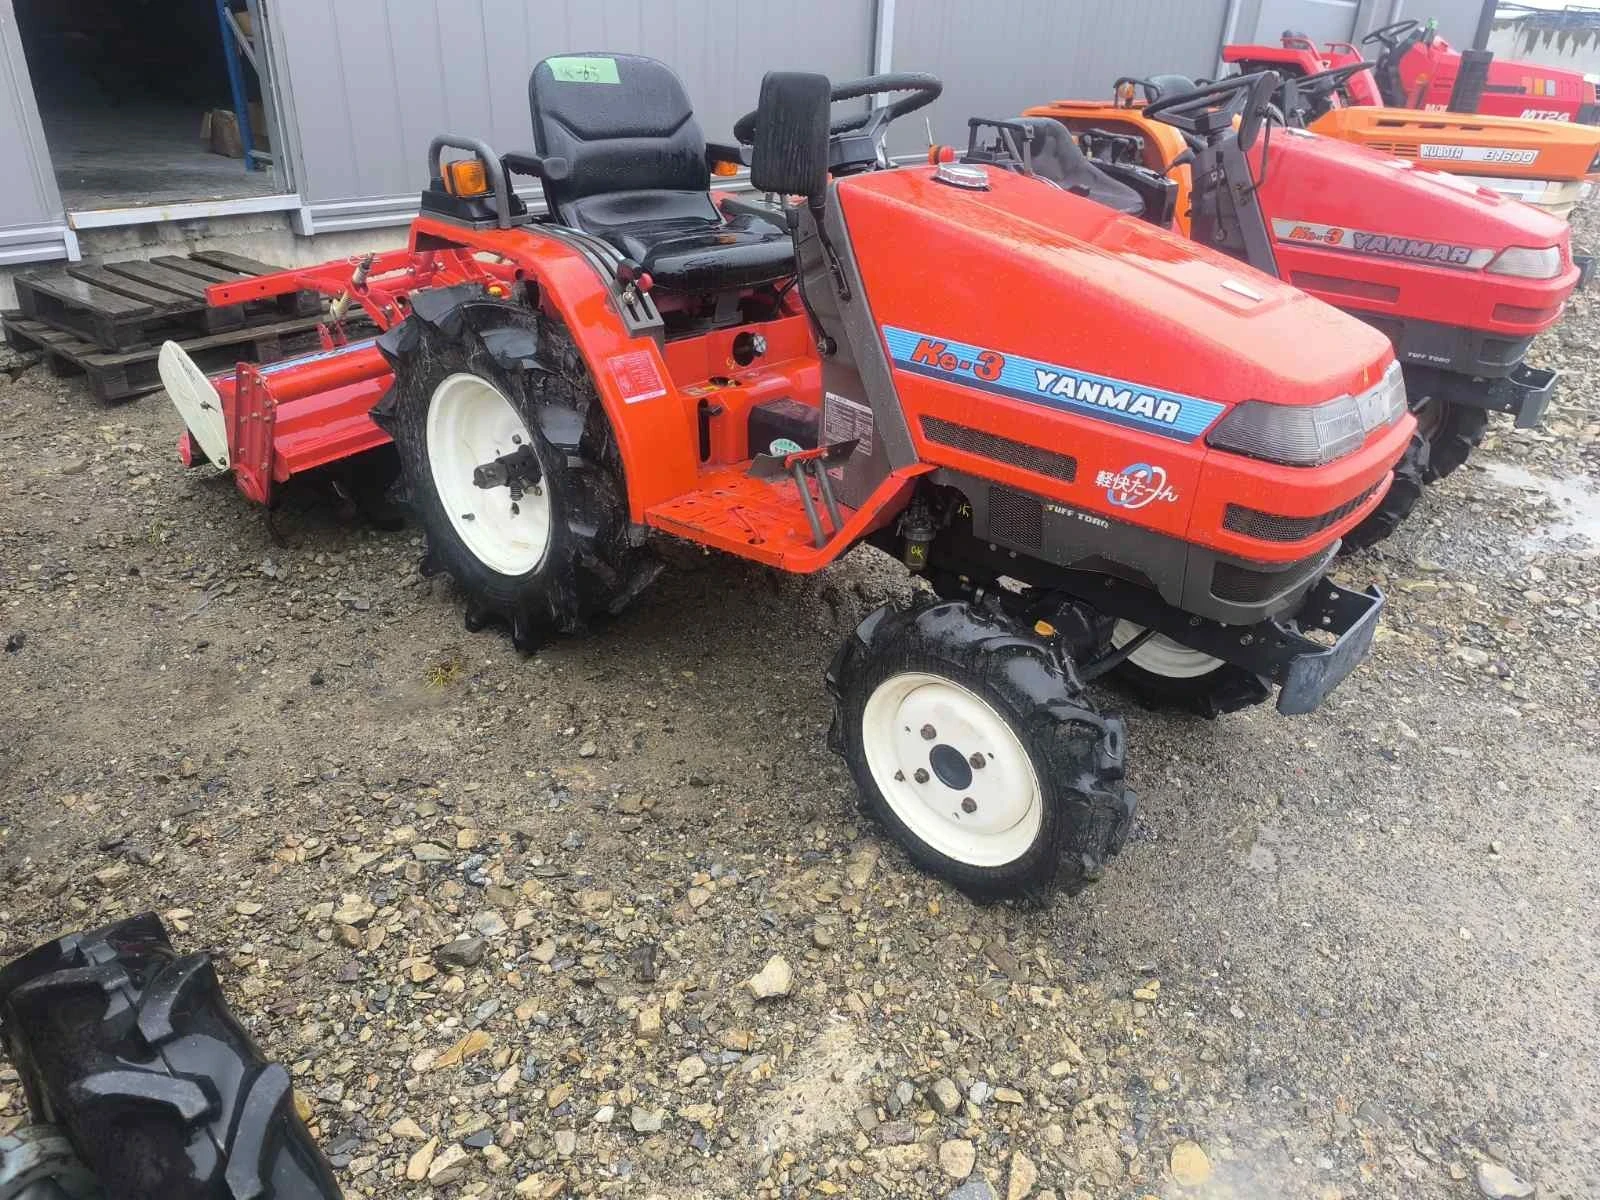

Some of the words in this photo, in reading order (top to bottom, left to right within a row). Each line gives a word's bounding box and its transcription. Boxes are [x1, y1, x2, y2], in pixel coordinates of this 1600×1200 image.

[1423, 145, 1463, 159] KUBOTA
[1352, 231, 1472, 264] YANMAR
[1035, 367, 1182, 424] YANMAR
